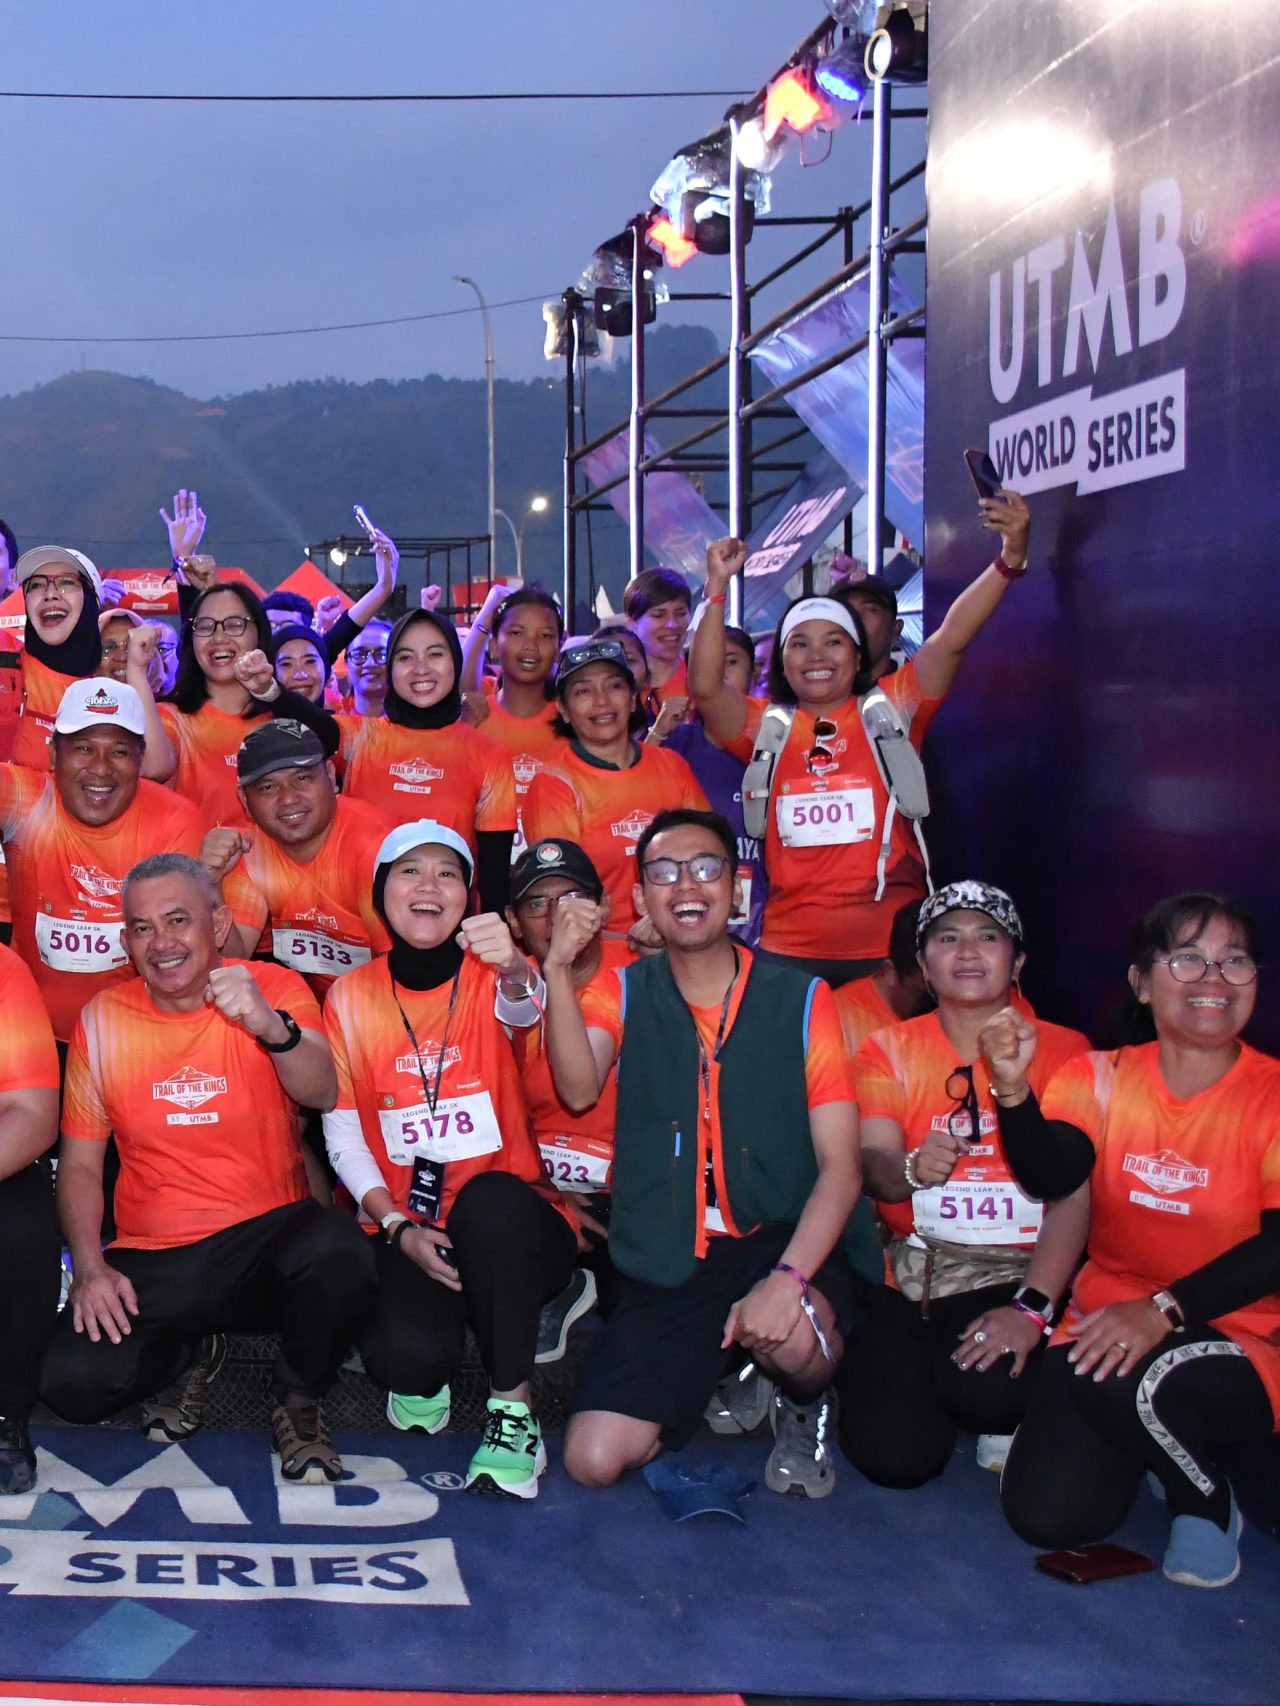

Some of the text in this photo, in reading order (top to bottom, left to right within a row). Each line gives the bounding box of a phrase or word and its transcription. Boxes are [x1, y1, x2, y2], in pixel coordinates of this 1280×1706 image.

[995, 396, 1176, 482] WORLD SERIES
[793, 802, 854, 826] 5001
[53, 921, 75, 929] LEGEND
[50, 930, 111, 954] 5016
[291, 938, 352, 965] 5133
[397, 1057, 418, 1071] TRAIL
[420, 1055, 428, 1065] OF
[154, 1079, 226, 1097] TRAIL OF THE KINGS
[402, 1109, 429, 1118] LEGEND
[432, 1104, 448, 1112] EAP
[401, 1111, 474, 1145] 5178
[1124, 1156, 1206, 1184] TRAIL OF THE KINGS
[940, 1196, 1014, 1220] 5141
[1155, 1200, 1181, 1212] UTMB
[1146, 1363, 1165, 1385] NIKE
[64, 1550, 429, 1592] SERIES
